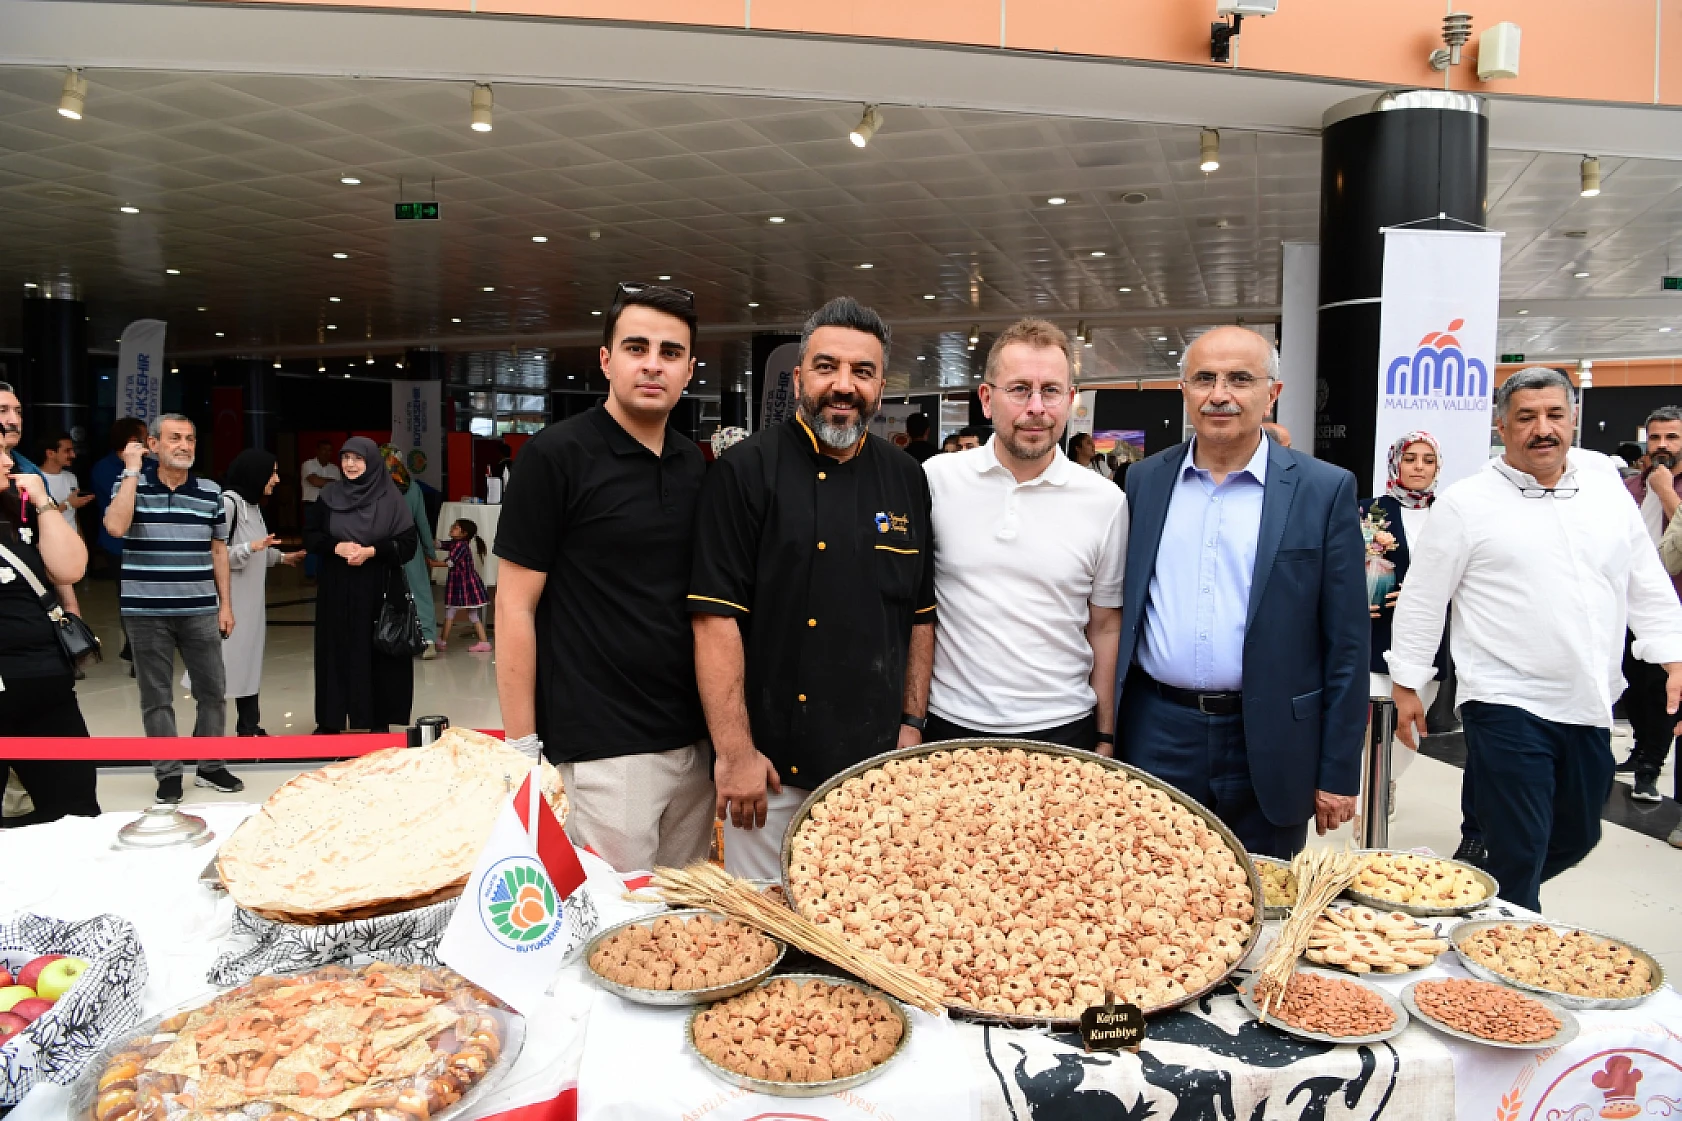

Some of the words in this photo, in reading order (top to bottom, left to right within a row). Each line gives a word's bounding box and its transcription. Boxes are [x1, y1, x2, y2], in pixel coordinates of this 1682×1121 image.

[1384, 398, 1439, 411] MALATYA
[1096, 1012, 1129, 1026] Kayısı
[1089, 1026, 1138, 1040] Kurabiye
